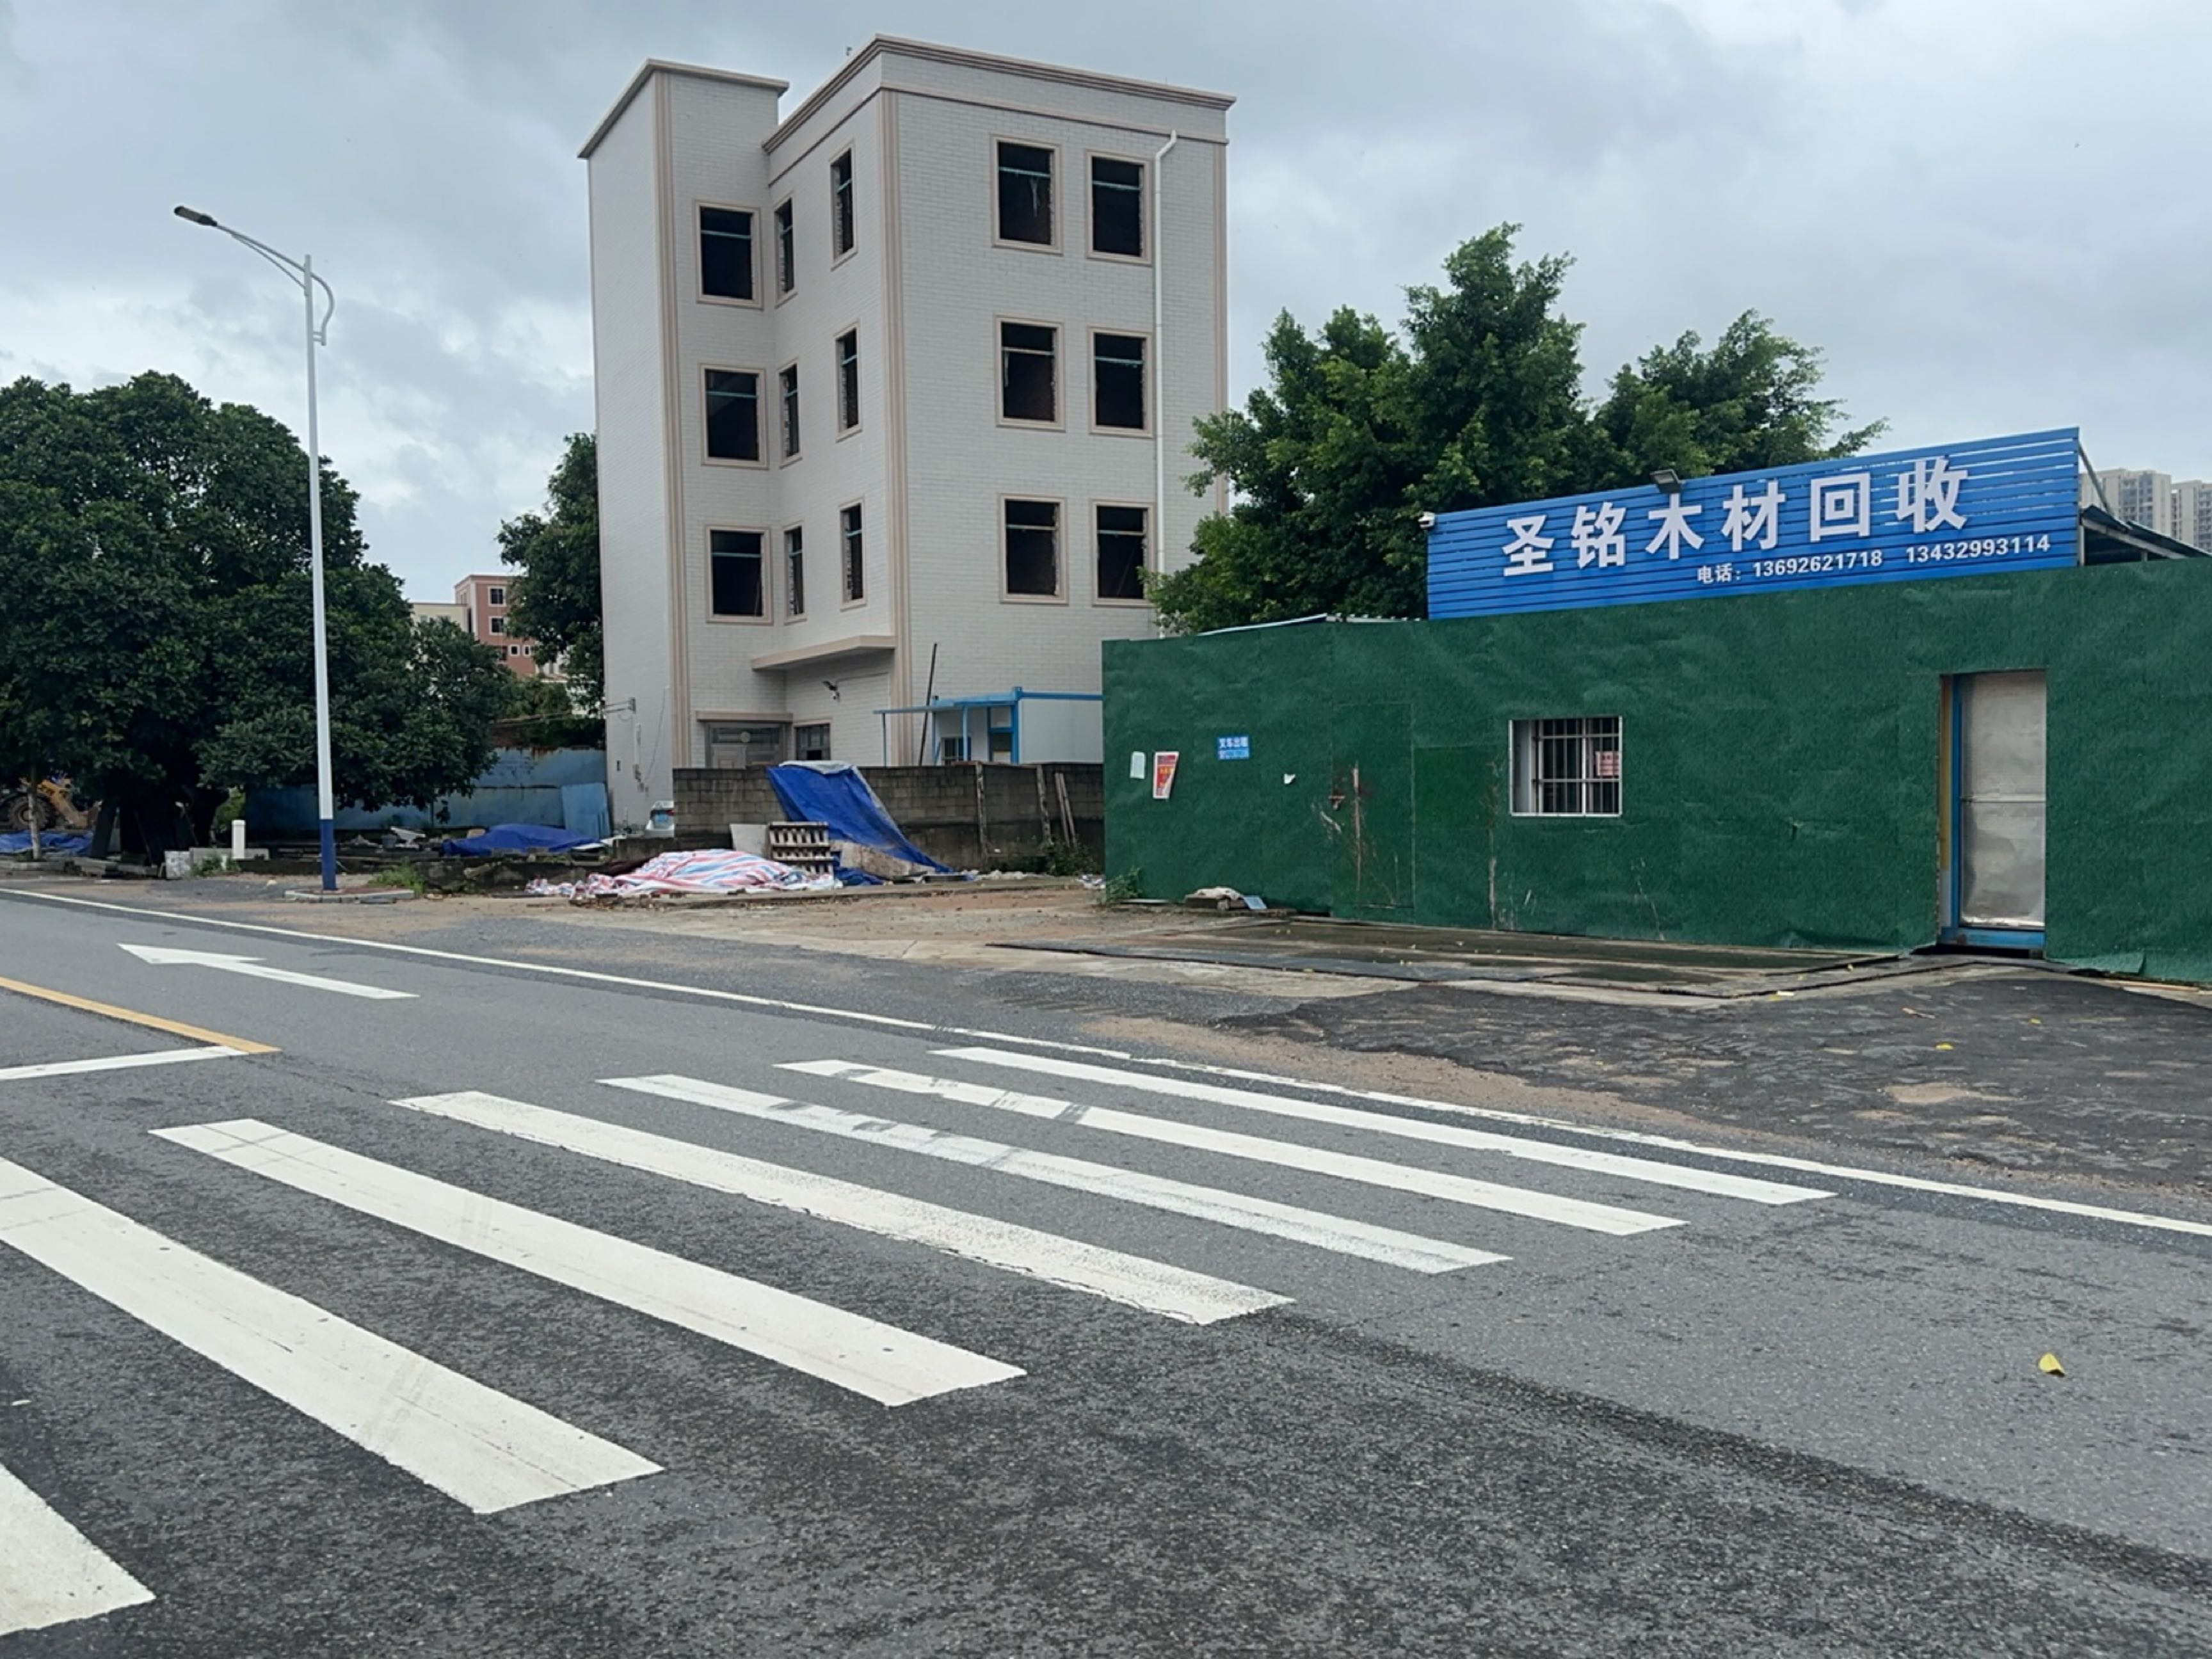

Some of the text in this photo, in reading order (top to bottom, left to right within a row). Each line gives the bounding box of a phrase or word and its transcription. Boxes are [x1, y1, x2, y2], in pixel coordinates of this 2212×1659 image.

[1502, 456, 1968, 577] 圣铭木材回收
[1752, 549, 1882, 577] 13692621718
[1906, 534, 2051, 563] 13432993114
